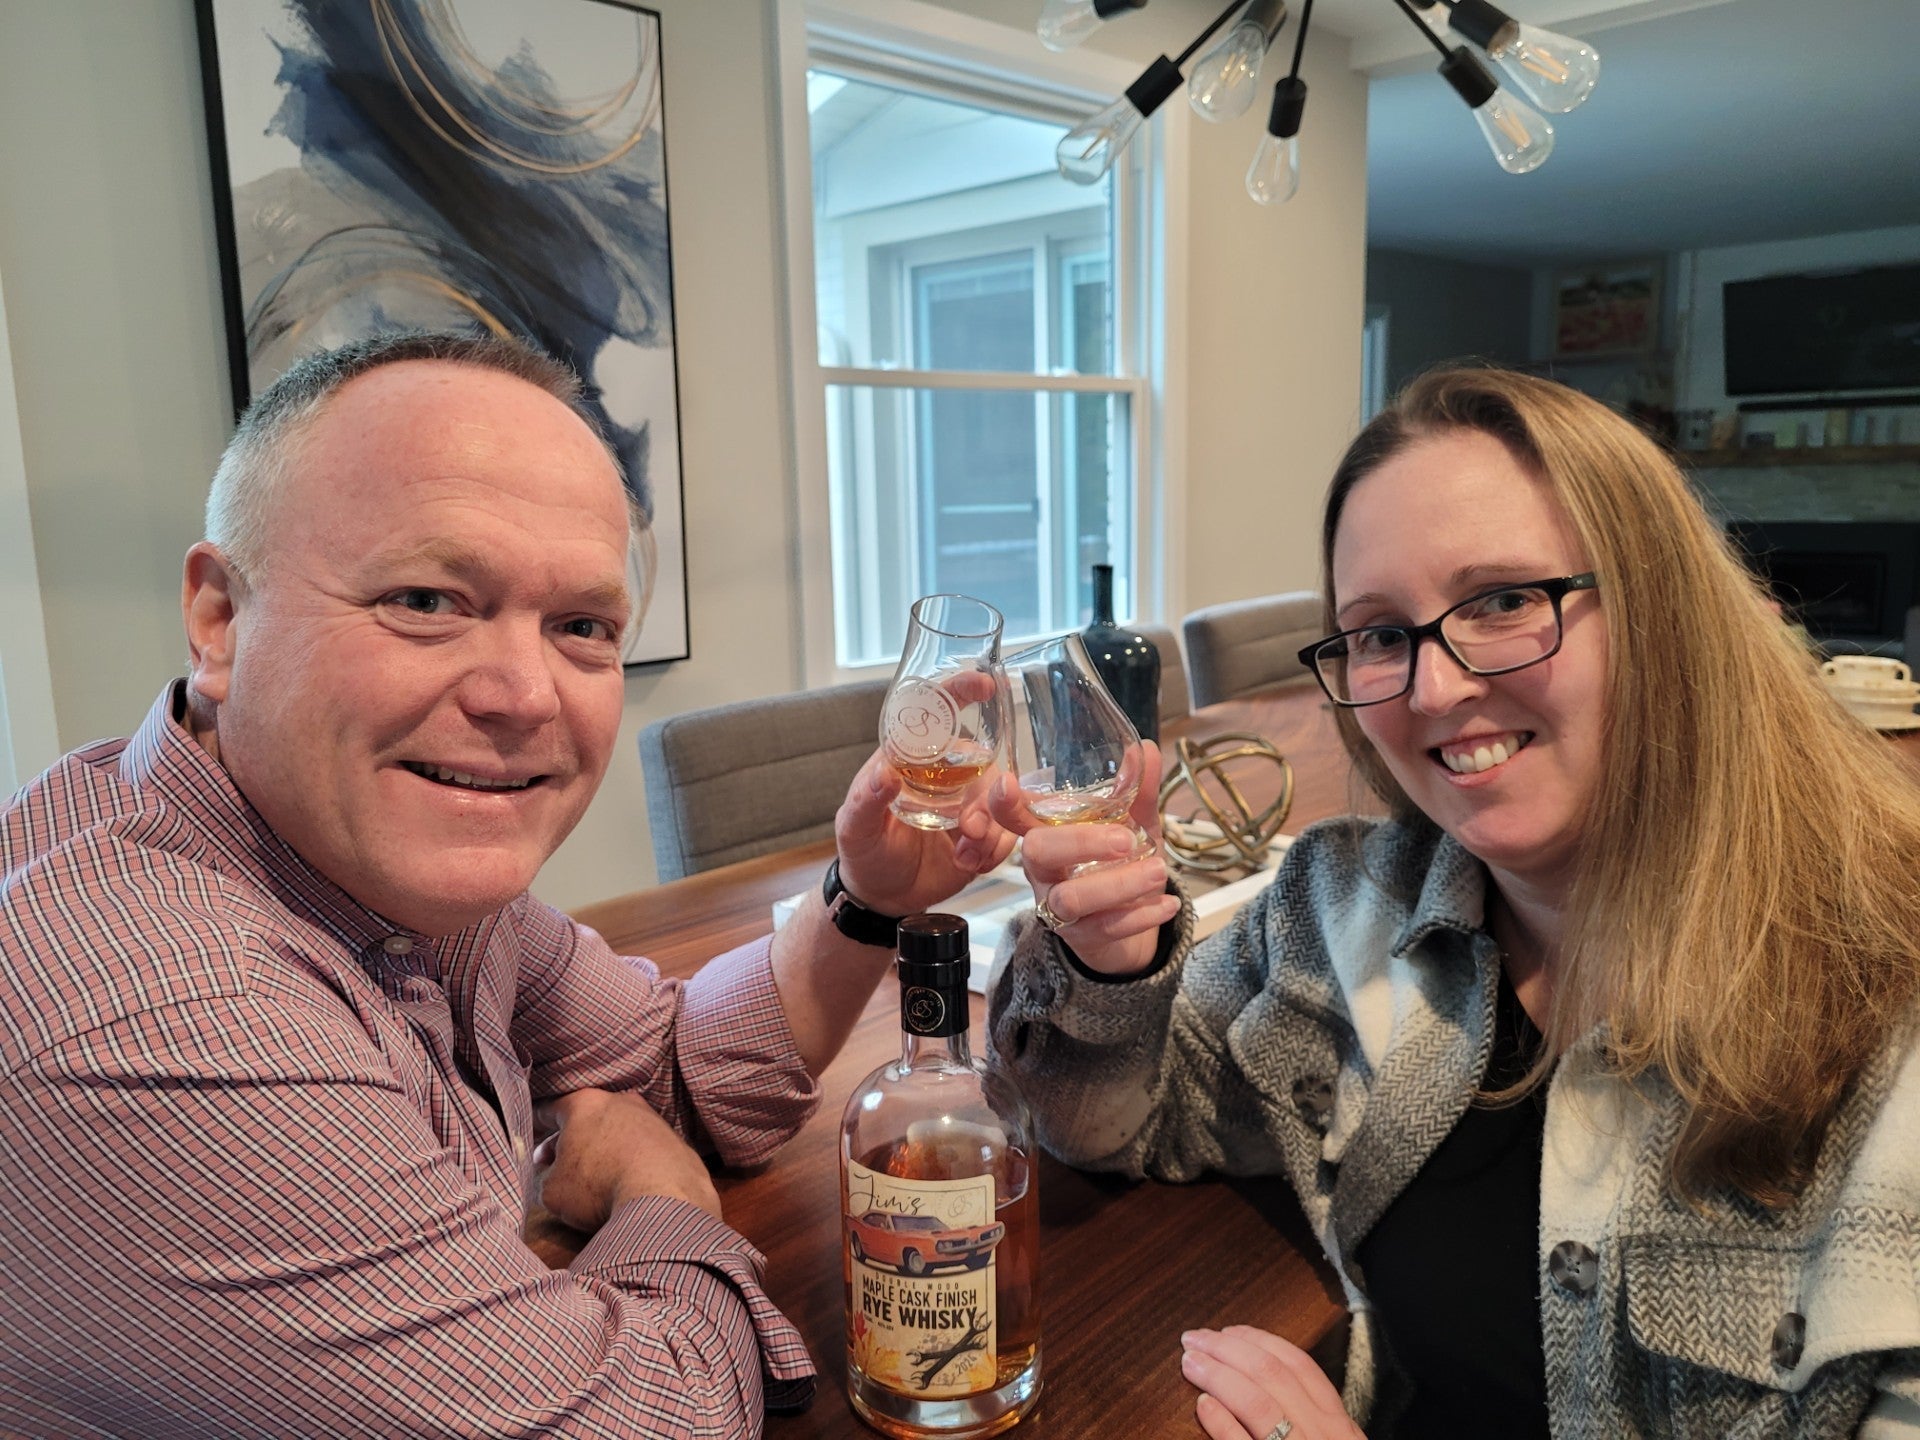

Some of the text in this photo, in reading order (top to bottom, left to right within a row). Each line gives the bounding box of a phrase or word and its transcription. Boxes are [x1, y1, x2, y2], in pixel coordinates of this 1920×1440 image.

[849, 1172, 926, 1218] Jim's
[863, 1275, 977, 1308] MAPLE CASK FINISH
[876, 1273, 959, 1290] DOUBLE WOOD
[863, 1291, 892, 1323] RYE
[899, 1307, 977, 1329] WHISKY
